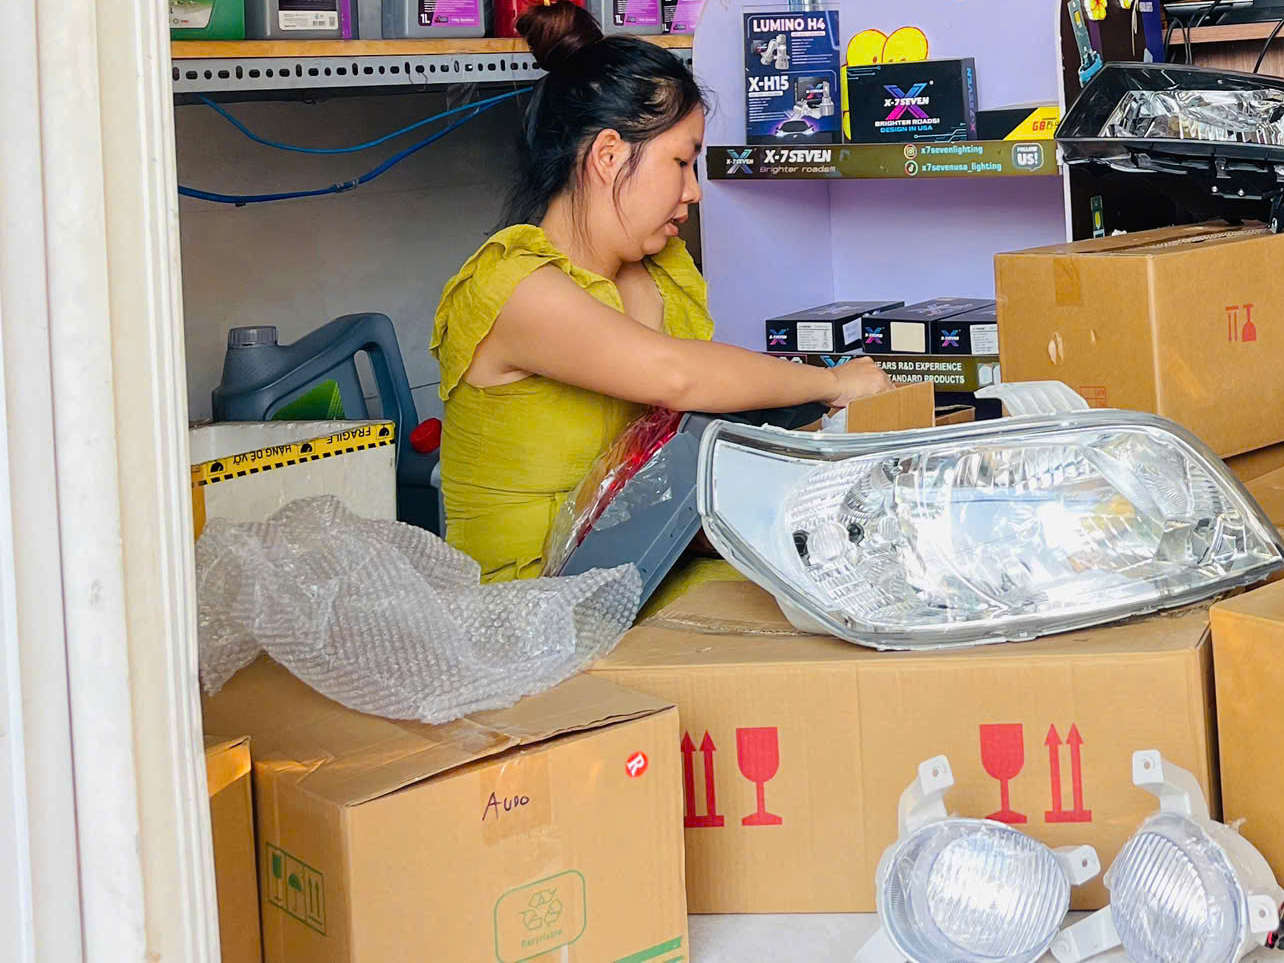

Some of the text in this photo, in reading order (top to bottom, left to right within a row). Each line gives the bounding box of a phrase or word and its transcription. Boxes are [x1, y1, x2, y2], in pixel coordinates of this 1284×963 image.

[420, 13, 430, 24] 1L
[753, 18, 826, 32] LUMINO H4
[748, 75, 790, 92] X-H15
[883, 96, 930, 108] X-7SEVEN
[874, 117, 940, 127] BRIGHTER ROADS!
[1031, 121, 1046, 132] G8
[918, 124, 933, 132] USA
[920, 145, 984, 156] x7sevenlighting
[764, 149, 832, 164] X-7SEVEN
[1016, 152, 1039, 165] US!
[759, 165, 800, 175] Brighter
[921, 163, 1002, 173] x7sevenusa_lighting
[898, 362, 914, 371] R&D
[916, 361, 963, 372] EXPERIENCE
[888, 374, 965, 384] TANDARD PRODUCTS
[326, 426, 371, 444] FRAGILE
